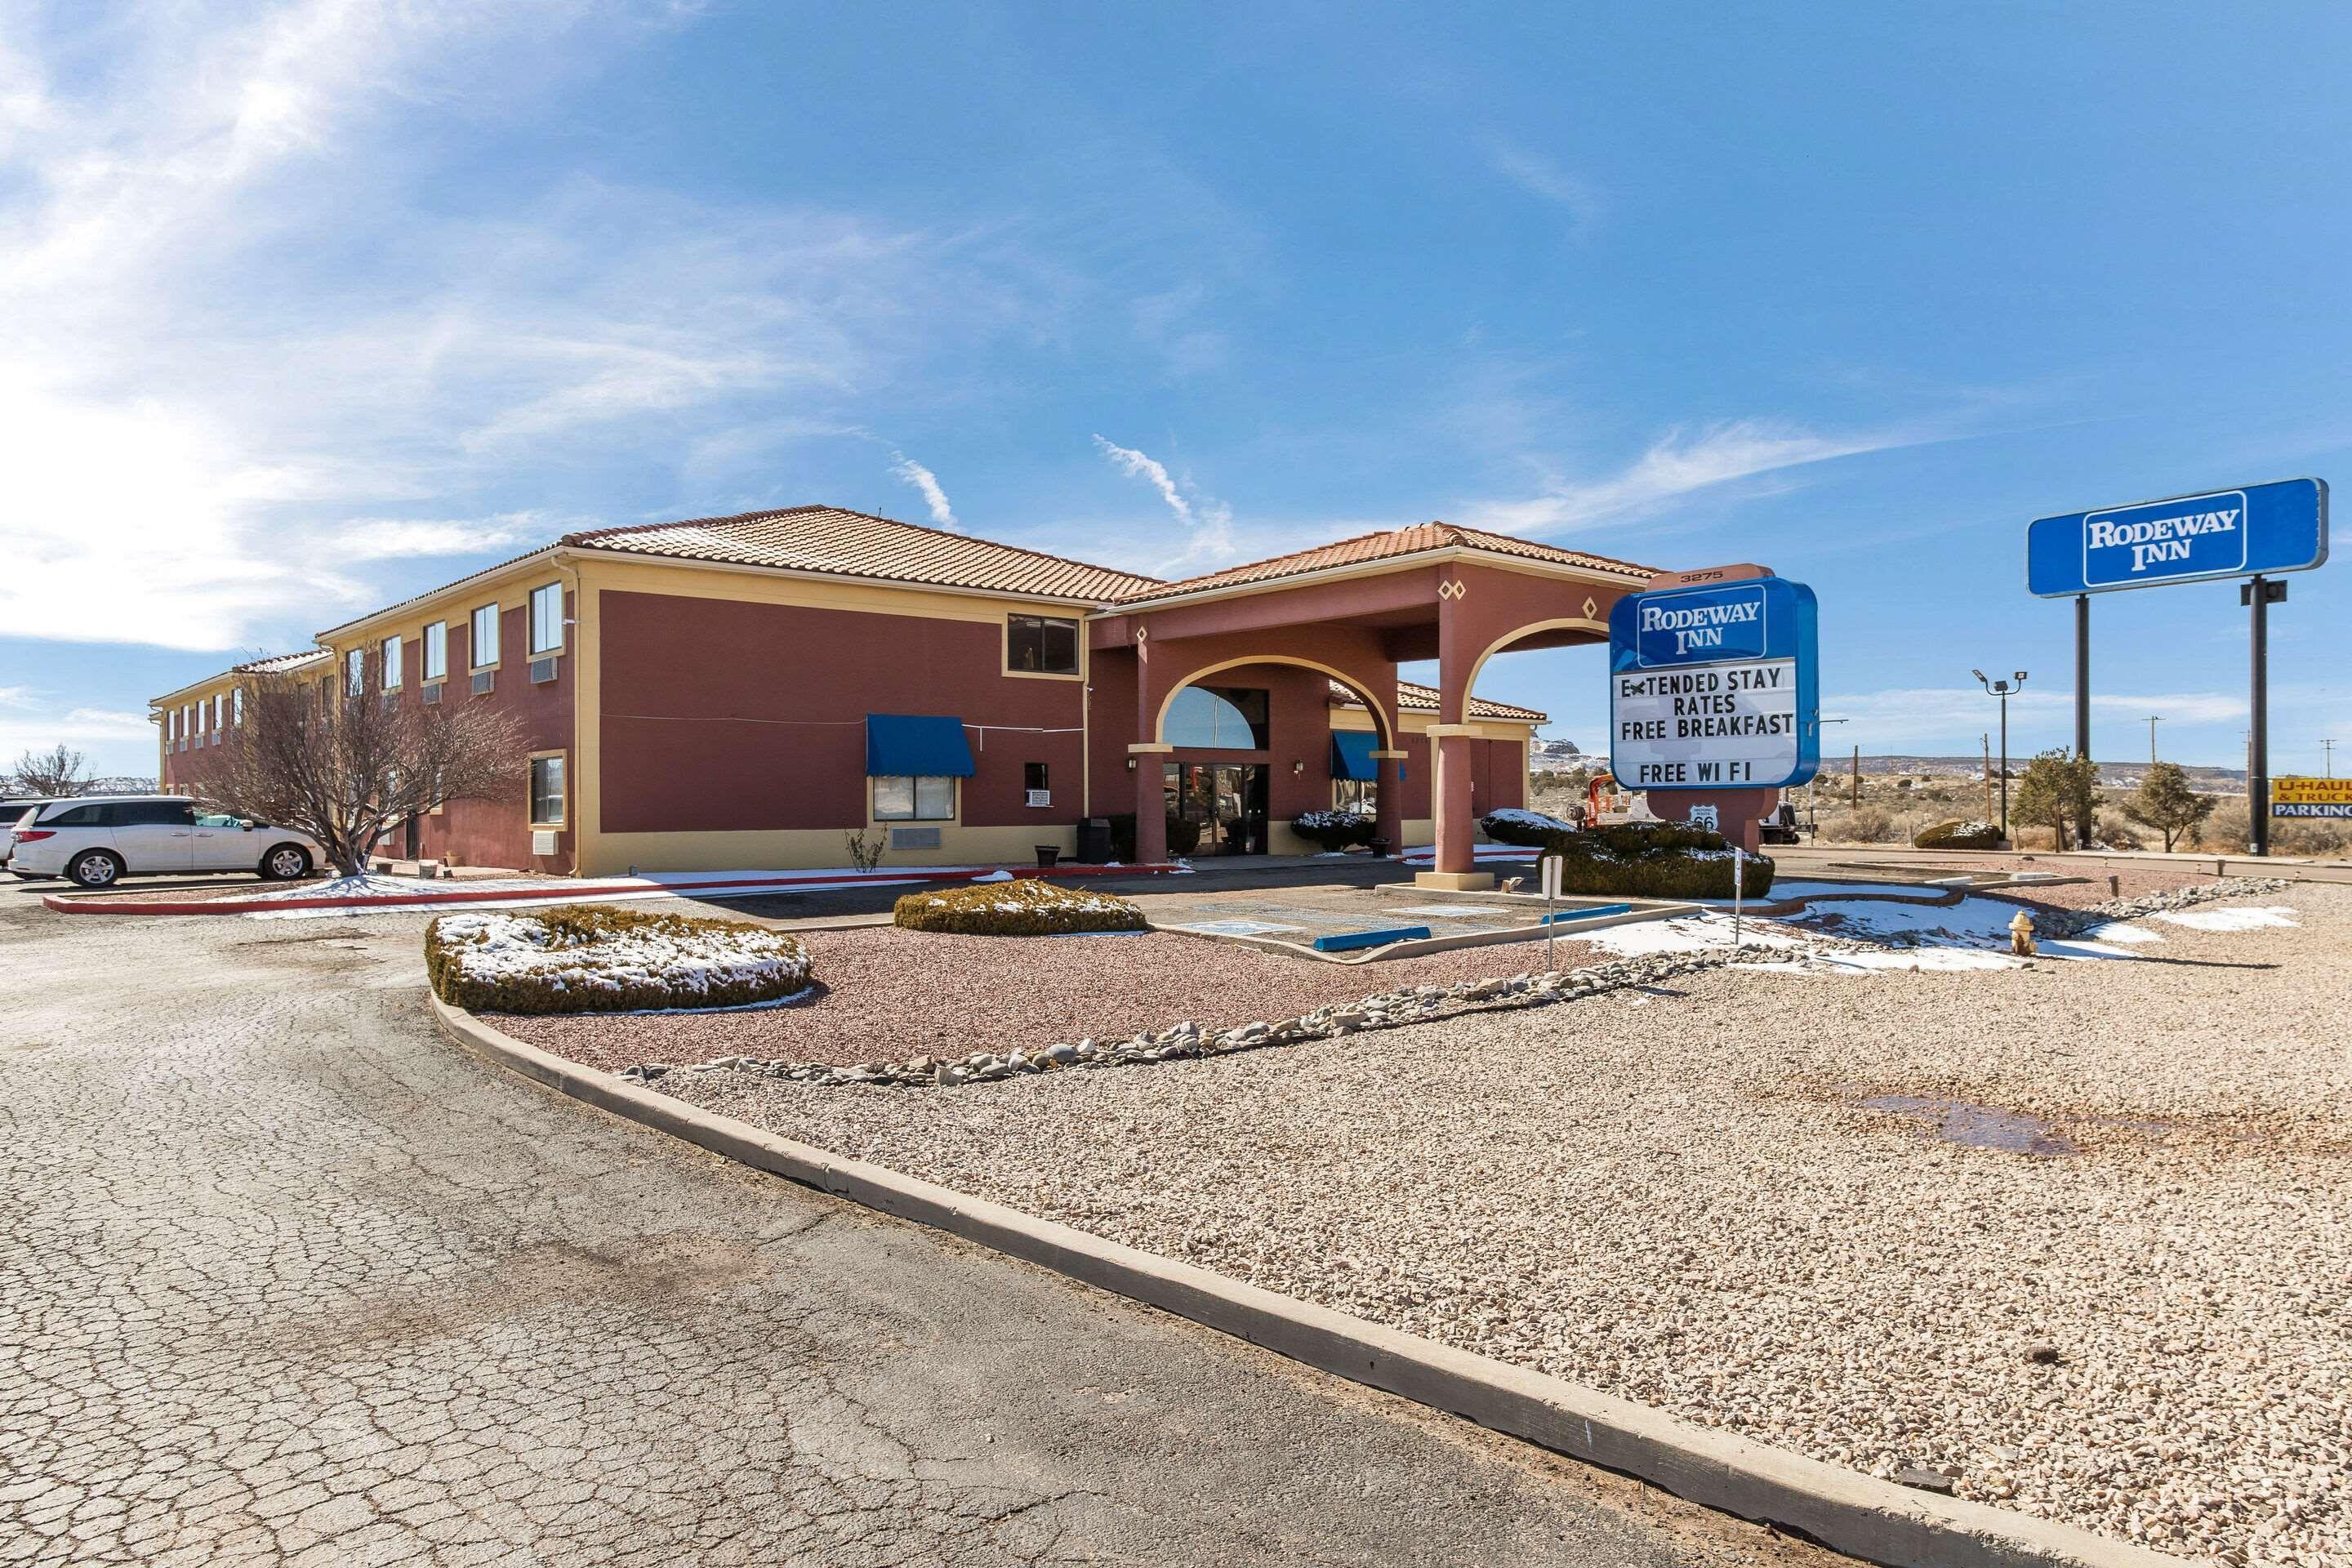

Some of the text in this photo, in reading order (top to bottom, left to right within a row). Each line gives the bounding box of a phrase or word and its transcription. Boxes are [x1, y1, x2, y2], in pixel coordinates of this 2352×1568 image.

[2089, 509, 2240, 550] RODEWAY
[2131, 539, 2193, 572] INN
[1680, 571, 1723, 583] 3275
[1642, 601, 1761, 632] RODEWAY
[1675, 626, 1723, 655] INN
[1727, 667, 1781, 691] STAY
[1674, 694, 1735, 715] RATES
[1621, 713, 1794, 741] FREE BREAKFAST
[1640, 763, 1686, 783] FREE
[2278, 792, 2291, 801] &
